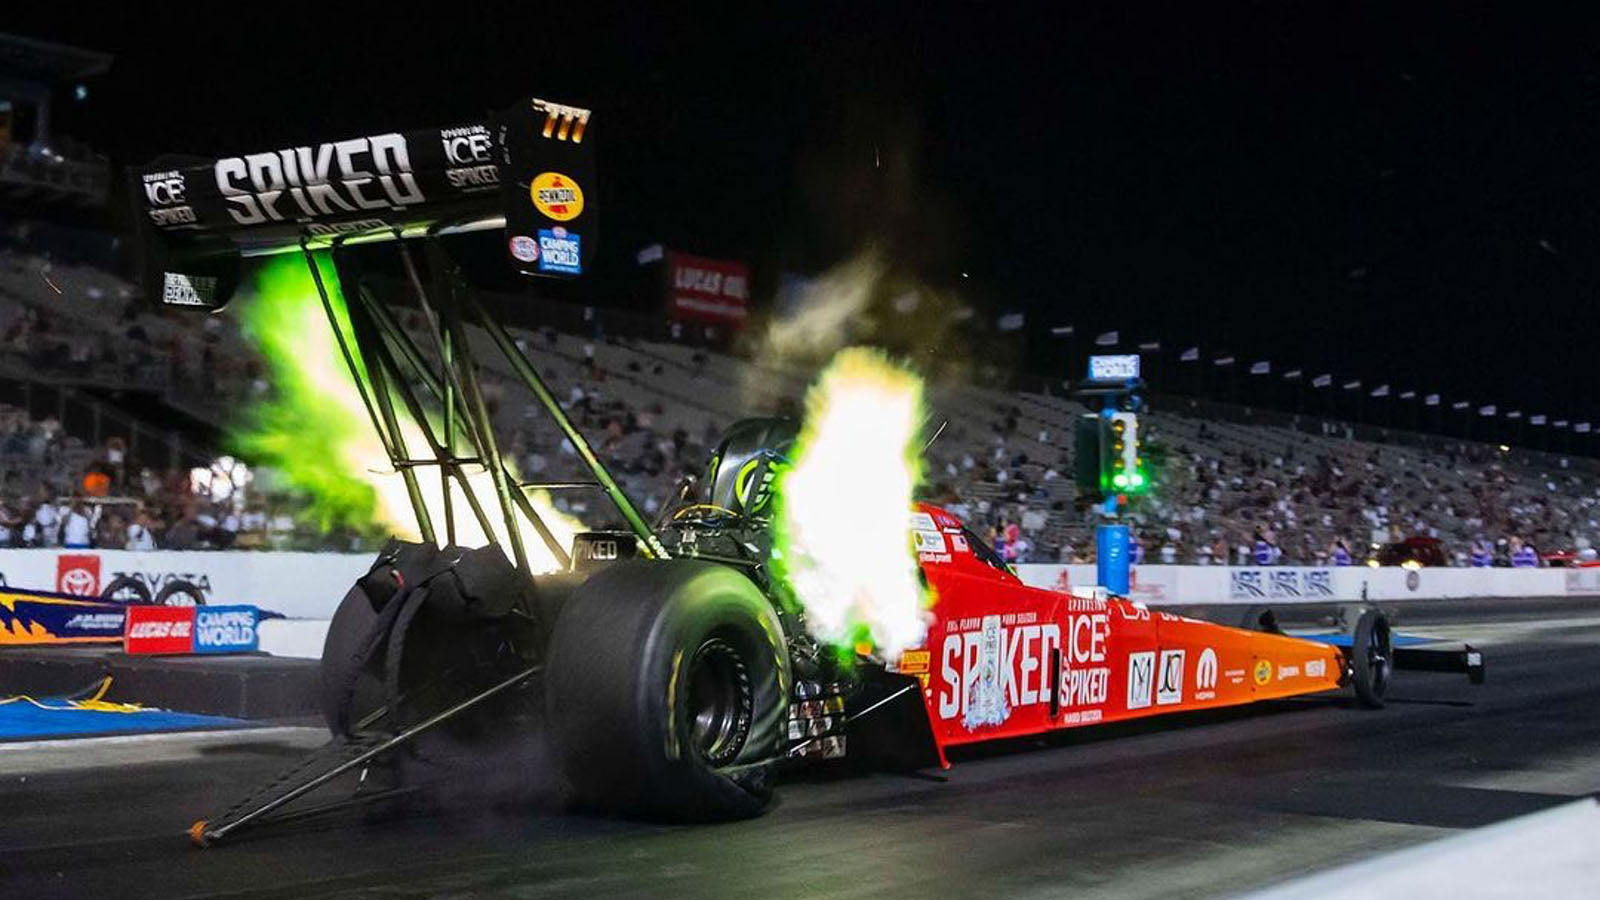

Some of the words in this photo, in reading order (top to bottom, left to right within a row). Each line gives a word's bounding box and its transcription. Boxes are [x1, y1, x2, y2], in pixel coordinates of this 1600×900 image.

[532, 98, 591, 143] 777
[442, 134, 492, 165] ICE
[143, 179, 186, 206] ICE
[215, 132, 426, 225] SPIKED
[541, 249, 579, 266] WORLD
[129, 622, 172, 639] LUCAS
[197, 611, 255, 628] CAMPING
[197, 625, 255, 647] WORLD
[1067, 613, 1109, 663] ICE
[1061, 667, 1108, 707] SPIKED
